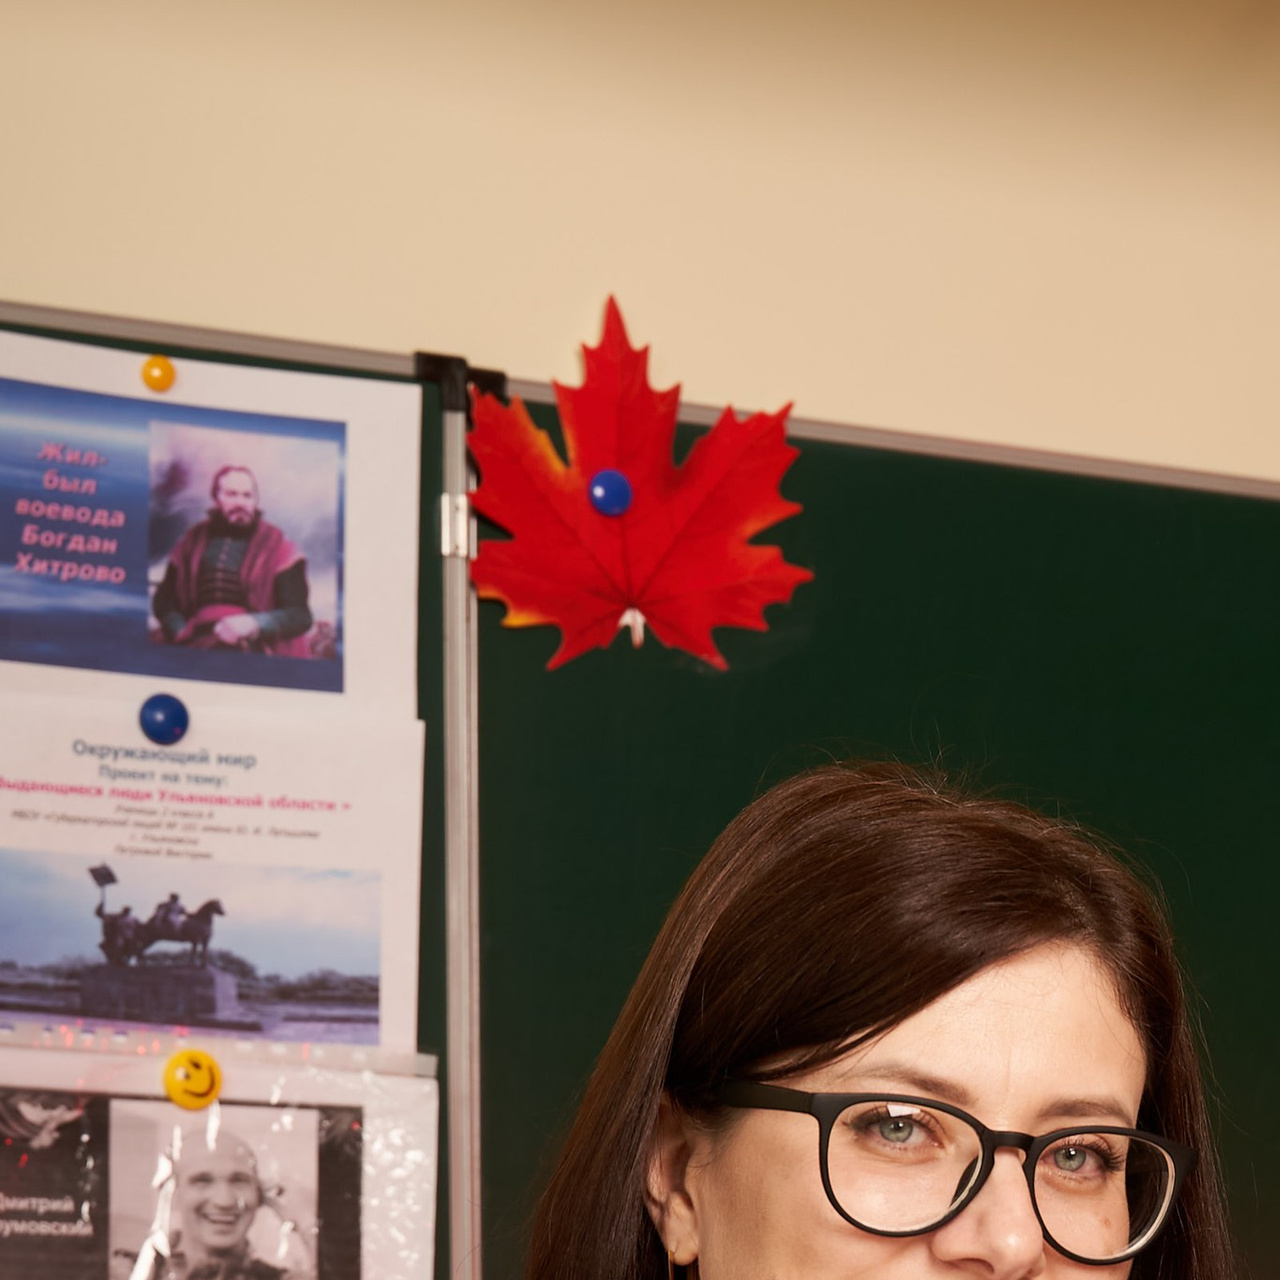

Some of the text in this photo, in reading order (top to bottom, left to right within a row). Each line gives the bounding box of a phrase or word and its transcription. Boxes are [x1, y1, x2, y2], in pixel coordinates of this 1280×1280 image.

[37, 441, 108, 468] Жил-
[43, 468, 97, 495] был
[15, 498, 126, 529] воевода
[22, 523, 118, 555] Богдан
[14, 551, 126, 584] Хитрово
[73, 739, 258, 771] Окружающий мир
[98, 764, 155, 782] Проект
[161, 773, 180, 784] на
